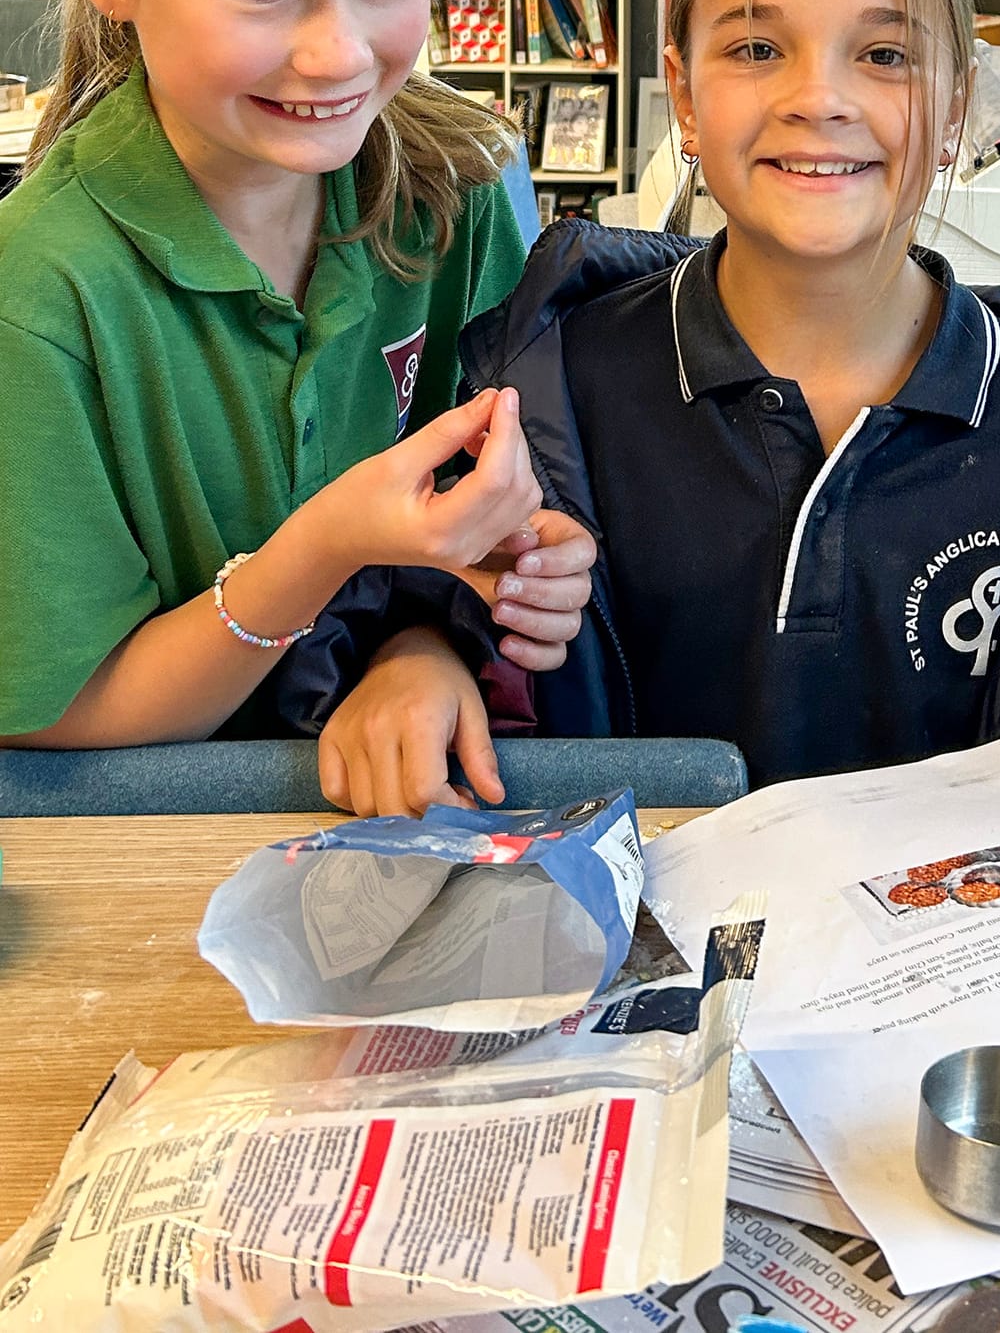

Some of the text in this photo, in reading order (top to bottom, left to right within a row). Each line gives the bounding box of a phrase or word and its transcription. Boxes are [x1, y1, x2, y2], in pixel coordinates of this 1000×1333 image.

[905, 576, 928, 643] PAUL'S
[911, 648, 925, 671] ST
[933, 932, 954, 943] Cool
[901, 939, 933, 953] biscuits
[945, 944, 967, 956] place
[866, 955, 888, 966] trays
[926, 953, 945, 963] 5cm
[963, 959, 981, 969] over
[904, 960, 925, 972] (2in)
[926, 964, 942, 973] add
[945, 966, 962, 975] low
[881, 969, 903, 981] apart
[902, 974, 916, 982] dry
[915, 970, 926, 979] to
[925, 972, 945, 983] heat
[868, 978, 880, 986] on
[966, 977, 988, 989] bowl
[845, 982, 868, 995] lined
[852, 981, 899, 1001] ingredients
[971, 985, 991, 996] Line
[800, 999, 820, 1009] then
[835, 998, 851, 1008] and
[948, 993, 970, 1004] trays
[928, 1002, 948, 1014] with
[896, 1011, 927, 1025] baking
[872, 1021, 896, 1034] paper
[744, 1215, 798, 1259] 10,000
[792, 1251, 831, 1275] pull
[825, 1271, 846, 1290] to
[758, 1260, 855, 1333] EXCLUSIVE
[843, 1278, 893, 1317] police
